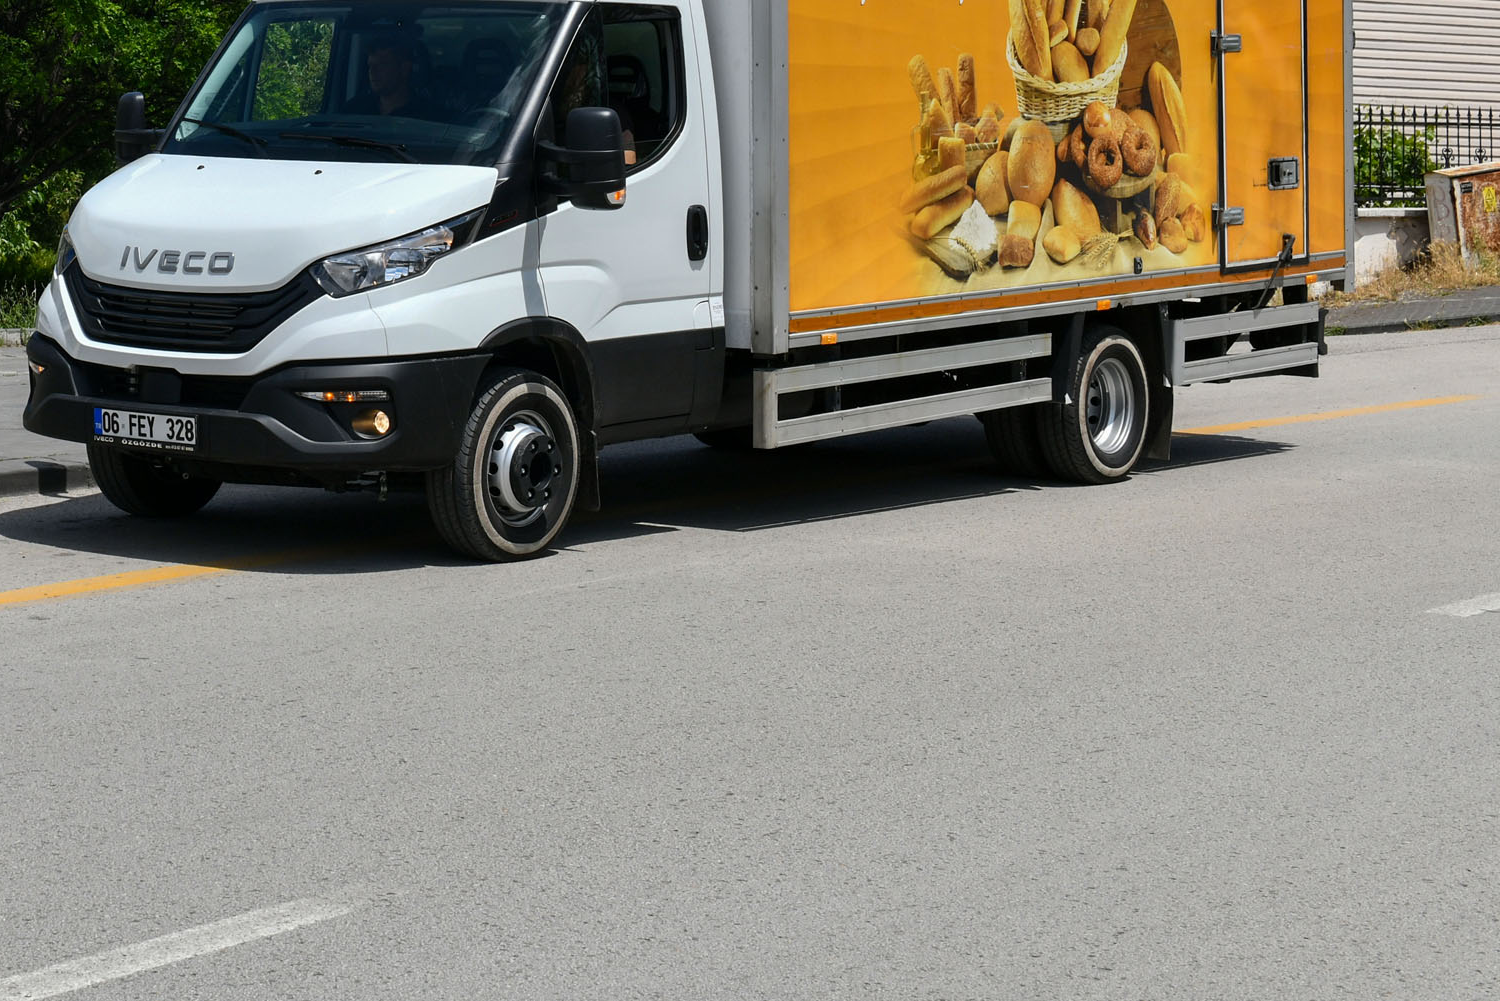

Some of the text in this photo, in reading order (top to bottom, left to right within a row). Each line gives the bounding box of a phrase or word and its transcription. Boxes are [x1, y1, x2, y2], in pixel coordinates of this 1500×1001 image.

[120, 245, 235, 275] IVECO
[93, 435, 114, 443] IVECO
[102, 411, 195, 442] 06 FEY 328
